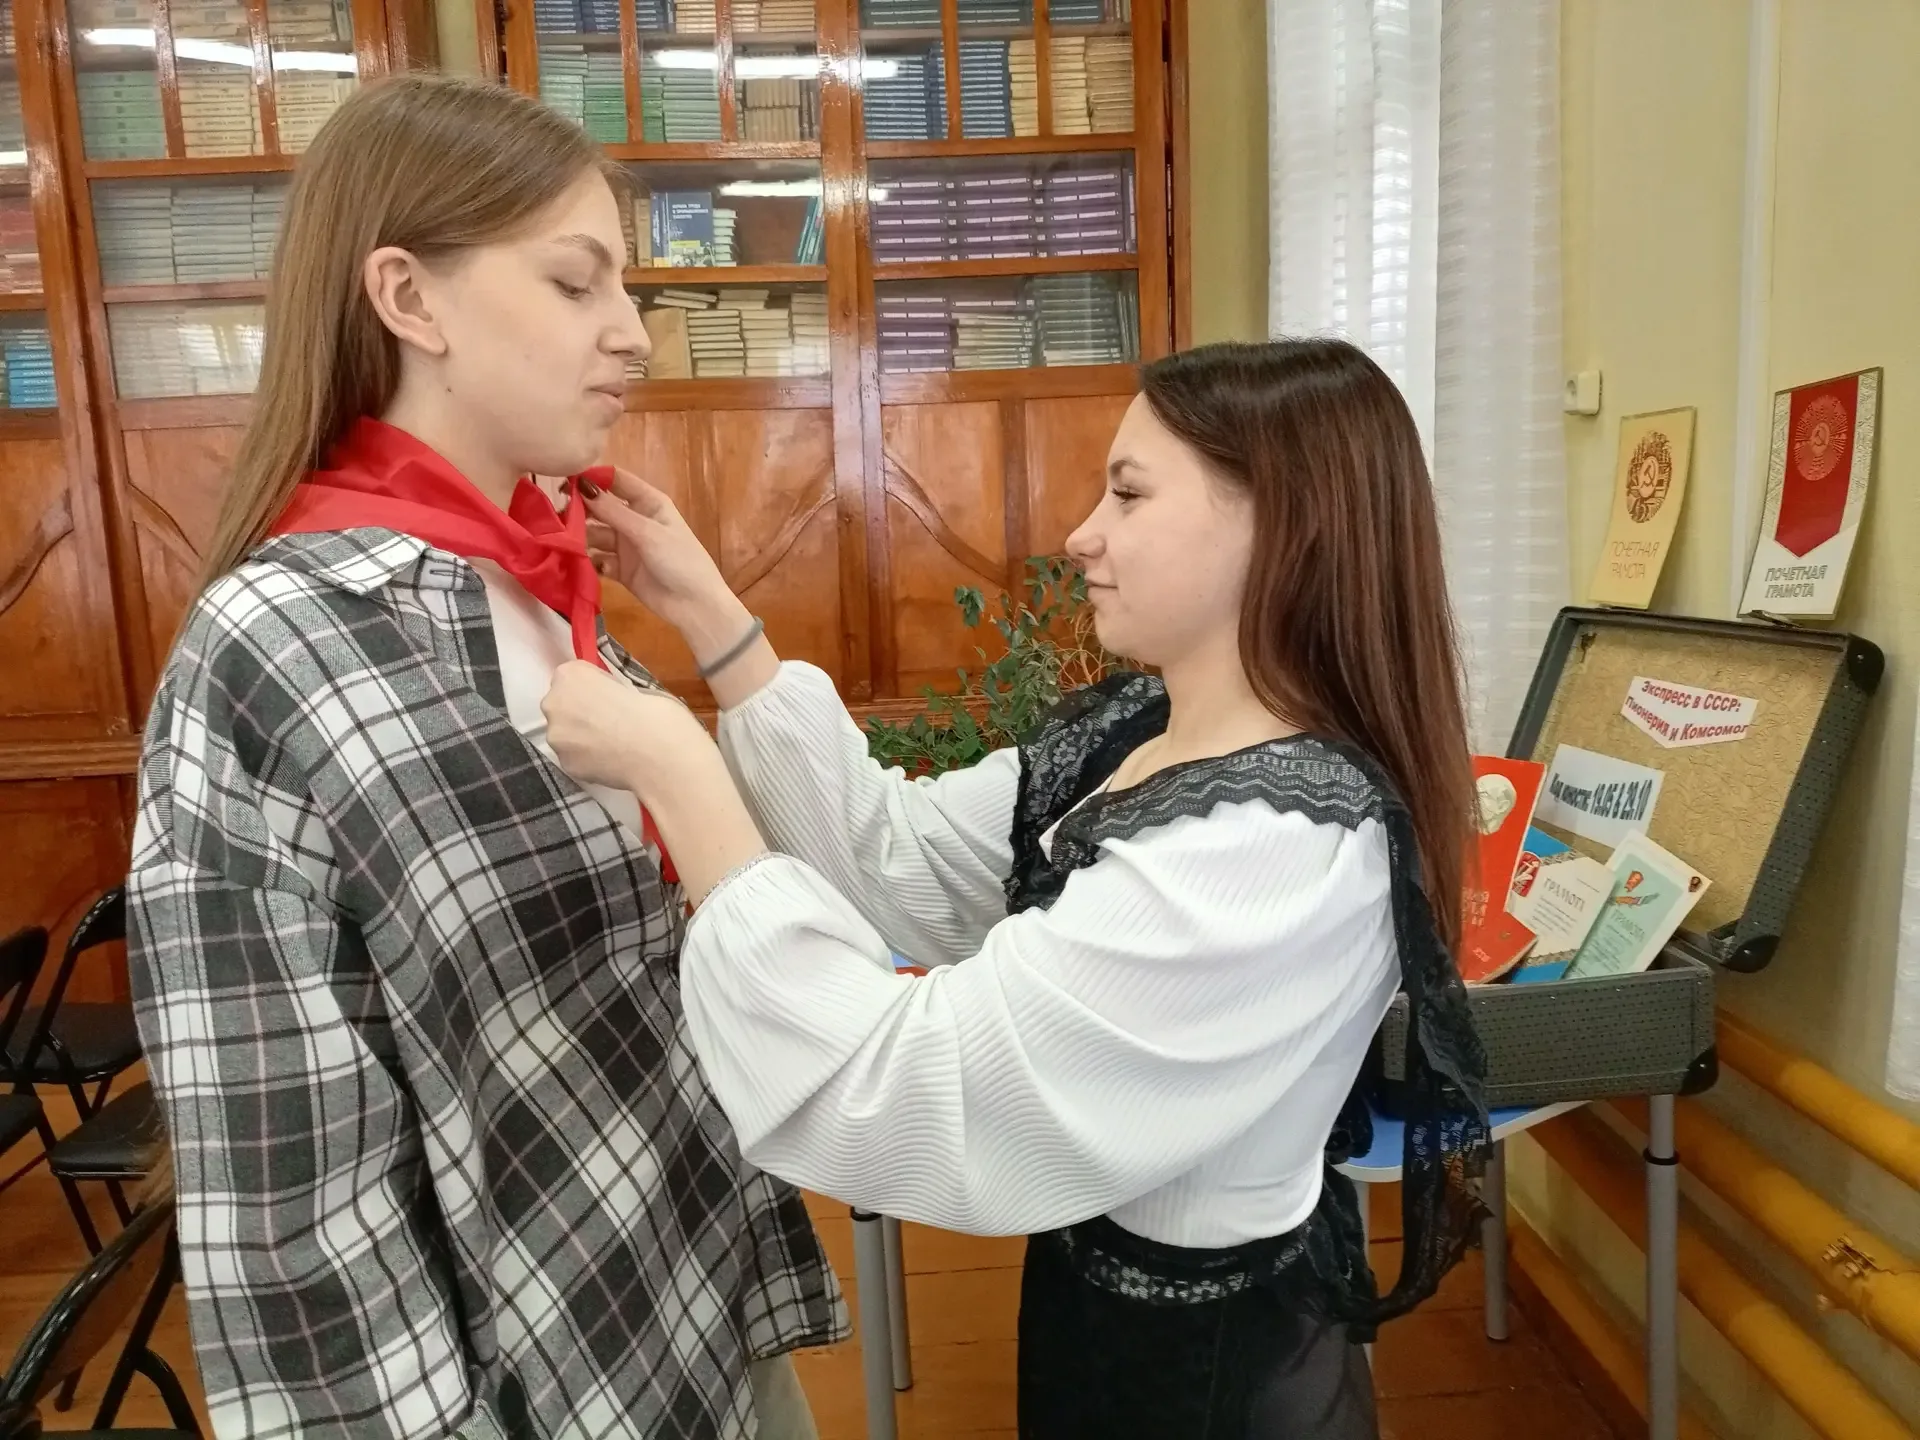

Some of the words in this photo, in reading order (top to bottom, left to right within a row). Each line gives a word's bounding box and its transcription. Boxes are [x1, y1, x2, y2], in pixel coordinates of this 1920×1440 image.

[1764, 565, 1828, 581] ПОЧЕТНАЯ
[1764, 583, 1815, 598] ГРАМОТА
[1641, 681, 1692, 708] Экспресс
[1691, 696, 1702, 709] в
[1703, 693, 1742, 712] СССР:
[1625, 696, 1670, 737] Пионерия
[1668, 727, 1680, 741] и
